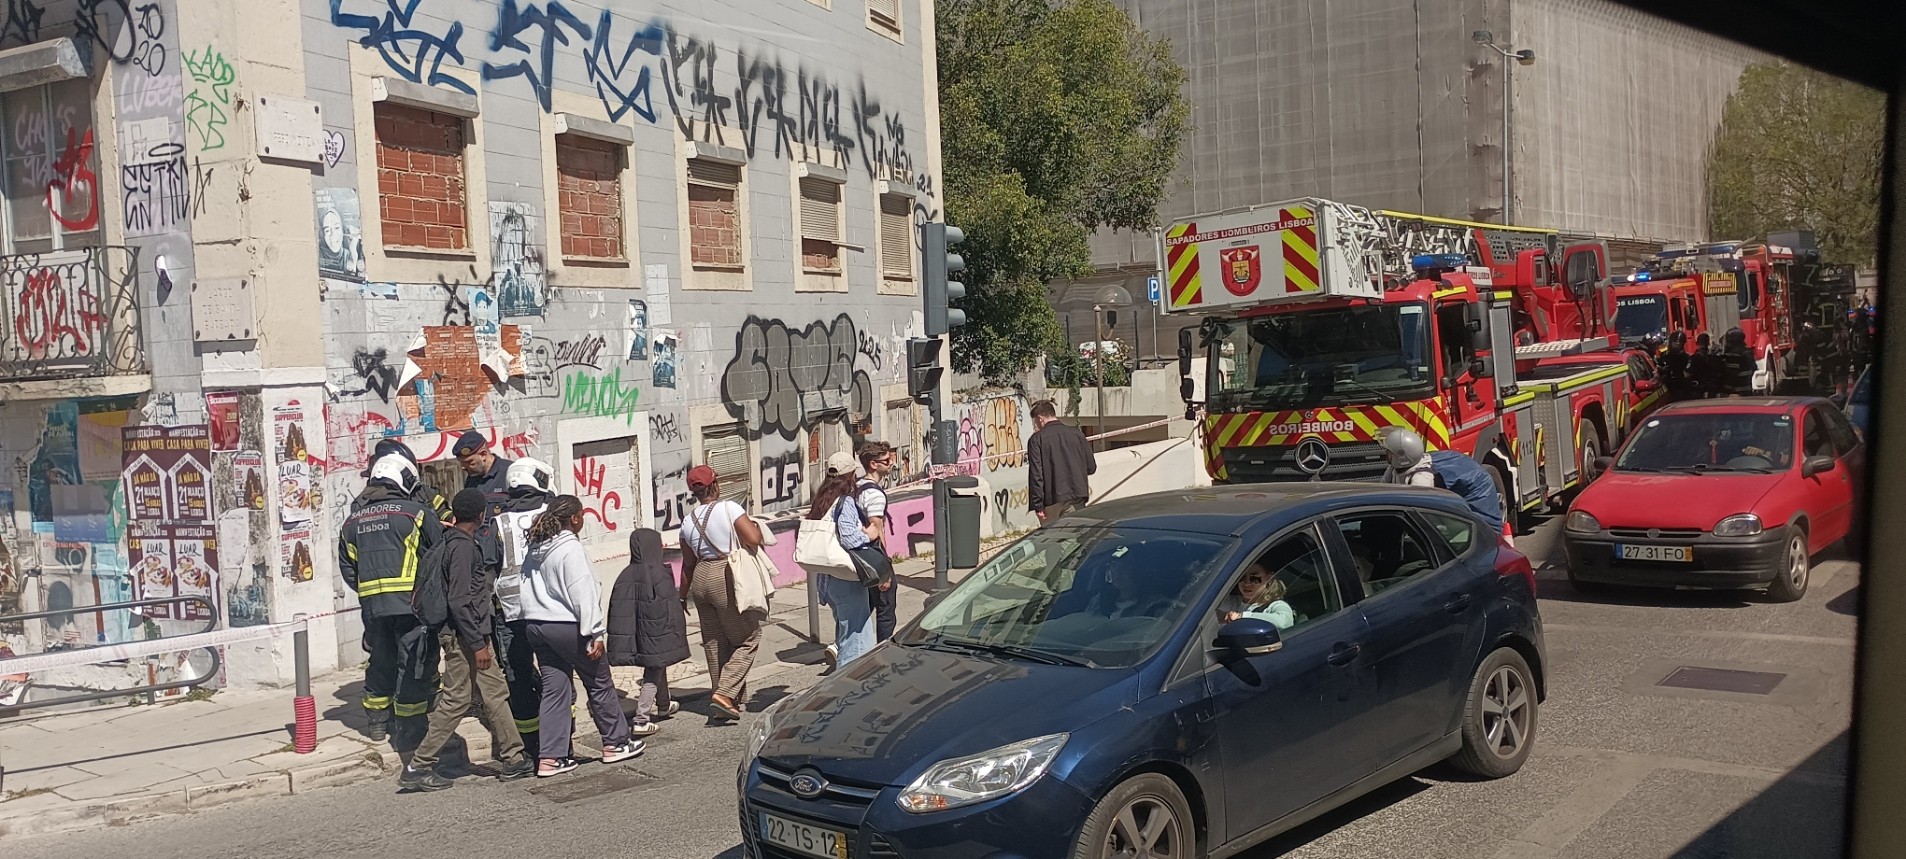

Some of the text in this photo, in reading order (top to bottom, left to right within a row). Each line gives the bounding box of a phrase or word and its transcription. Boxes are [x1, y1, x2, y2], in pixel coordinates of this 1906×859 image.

[133, 40, 166, 77] 20
[1166, 232, 1219, 246] SAPADORES
[1279, 218, 1315, 230] LISBOA
[1151, 280, 1159, 299] P
[1627, 298, 1656, 307] LISBOA
[168, 427, 199, 438] MANIFESTAÇÃO
[123, 439, 165, 452] CASA PARA VIVER
[166, 439, 209, 450] CASA PARA VIVER
[280, 463, 307, 478] LUAR
[134, 486, 145, 504] 21
[178, 486, 188, 504] 21
[351, 503, 402, 520] SAPADORES
[357, 522, 390, 534] Lisboa
[281, 530, 310, 541] SUPPERCLUB
[146, 543, 168, 556] LUAR
[178, 544, 202, 557] LUAR
[794, 778, 813, 792] Ford
